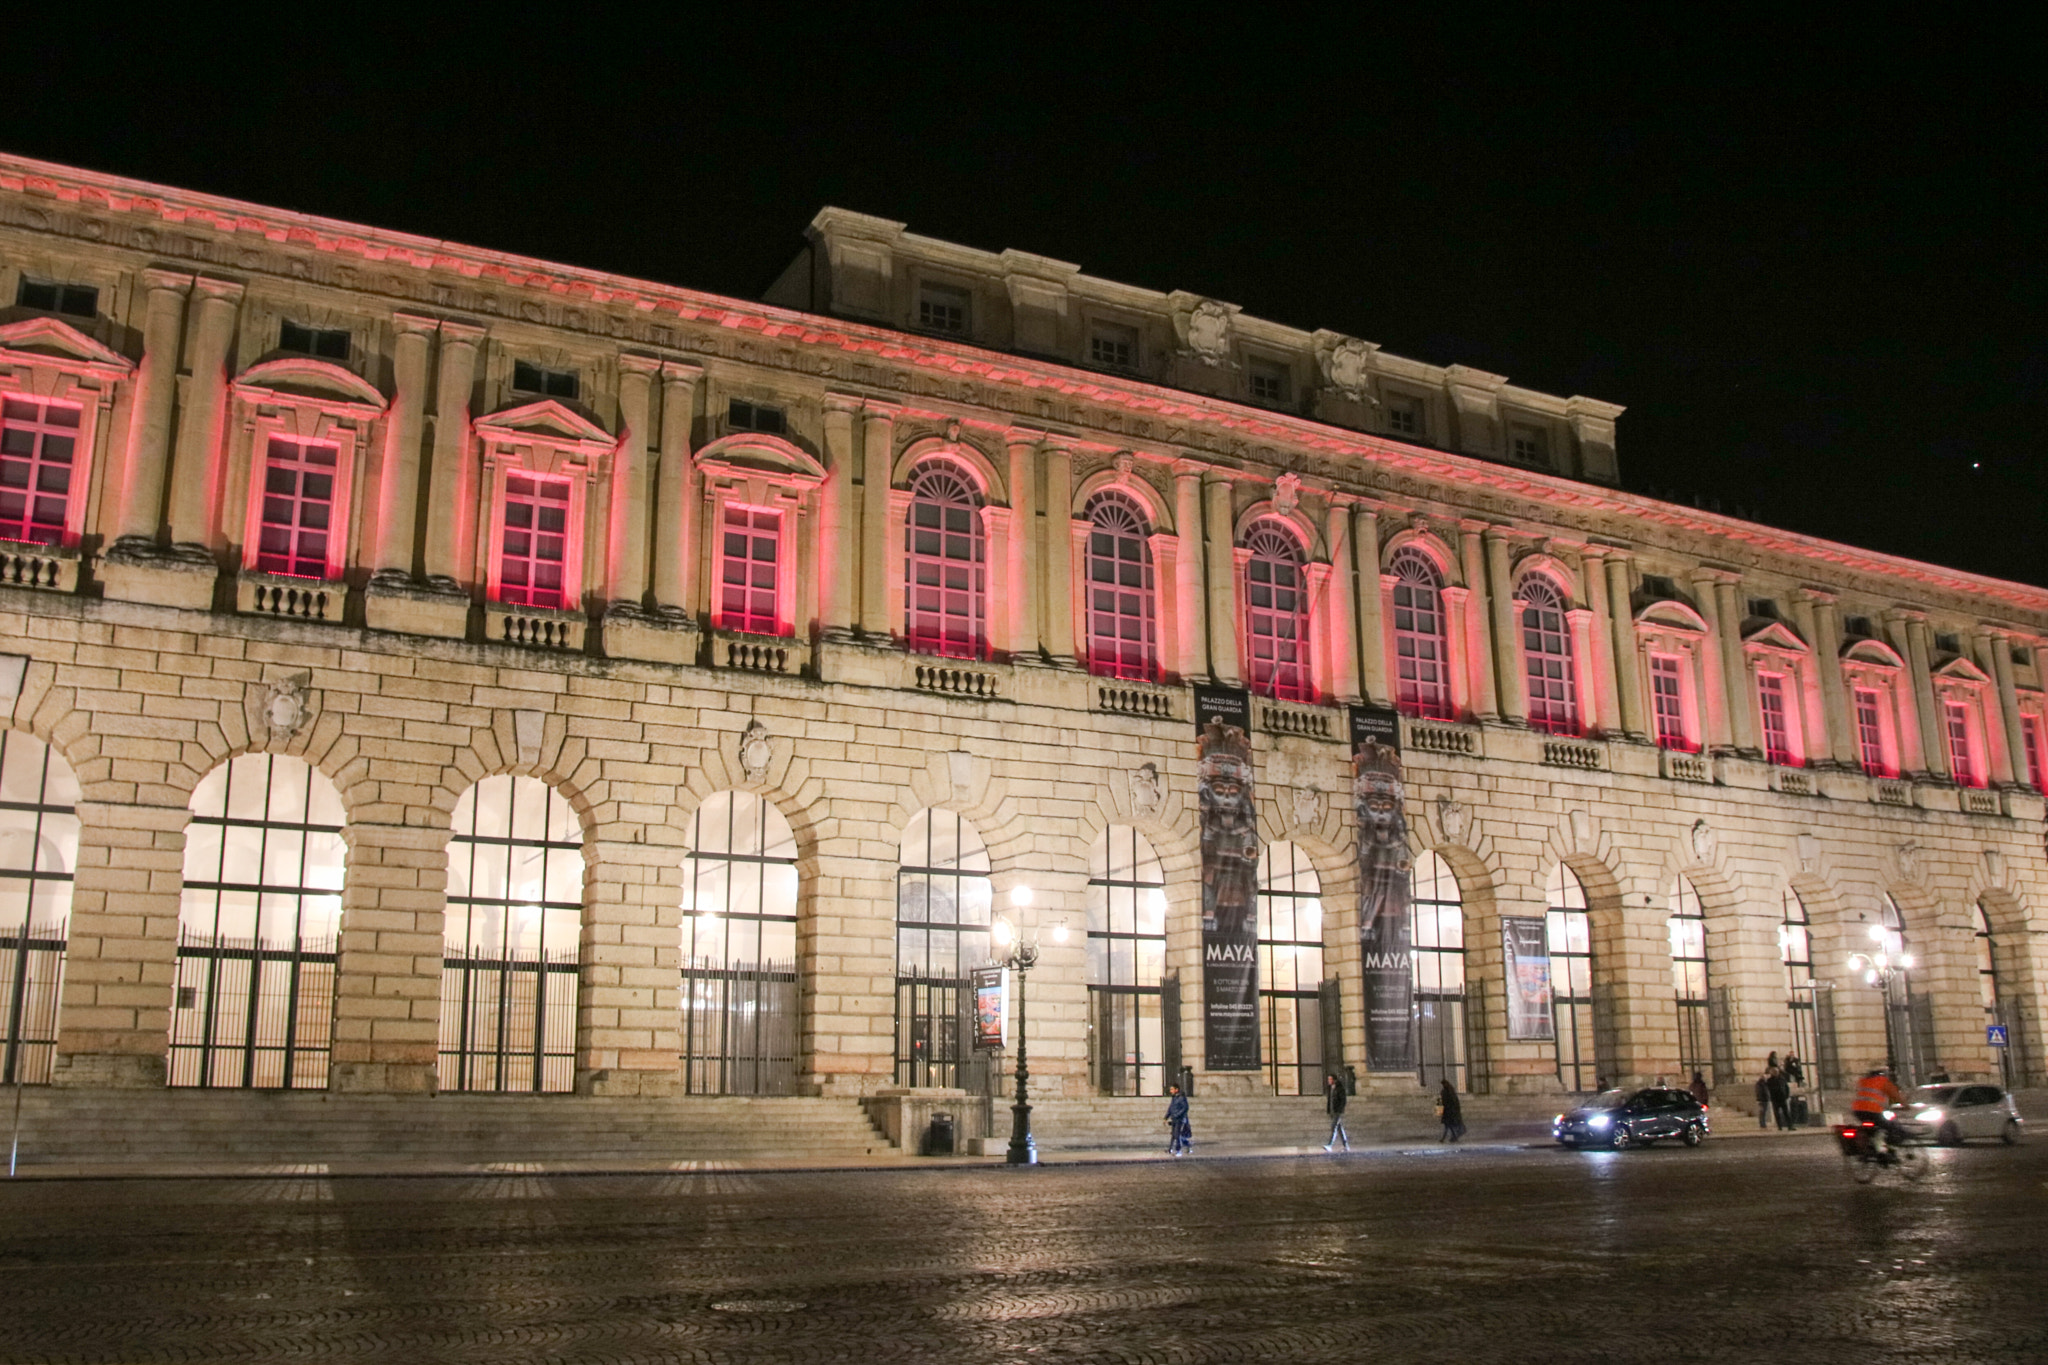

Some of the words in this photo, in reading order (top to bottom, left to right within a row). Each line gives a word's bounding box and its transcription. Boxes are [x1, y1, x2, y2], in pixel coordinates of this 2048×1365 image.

[1201, 696, 1225, 704] PALAZZO
[1206, 943, 1255, 962] MAYA
[1365, 951, 1410, 969] MAYA
